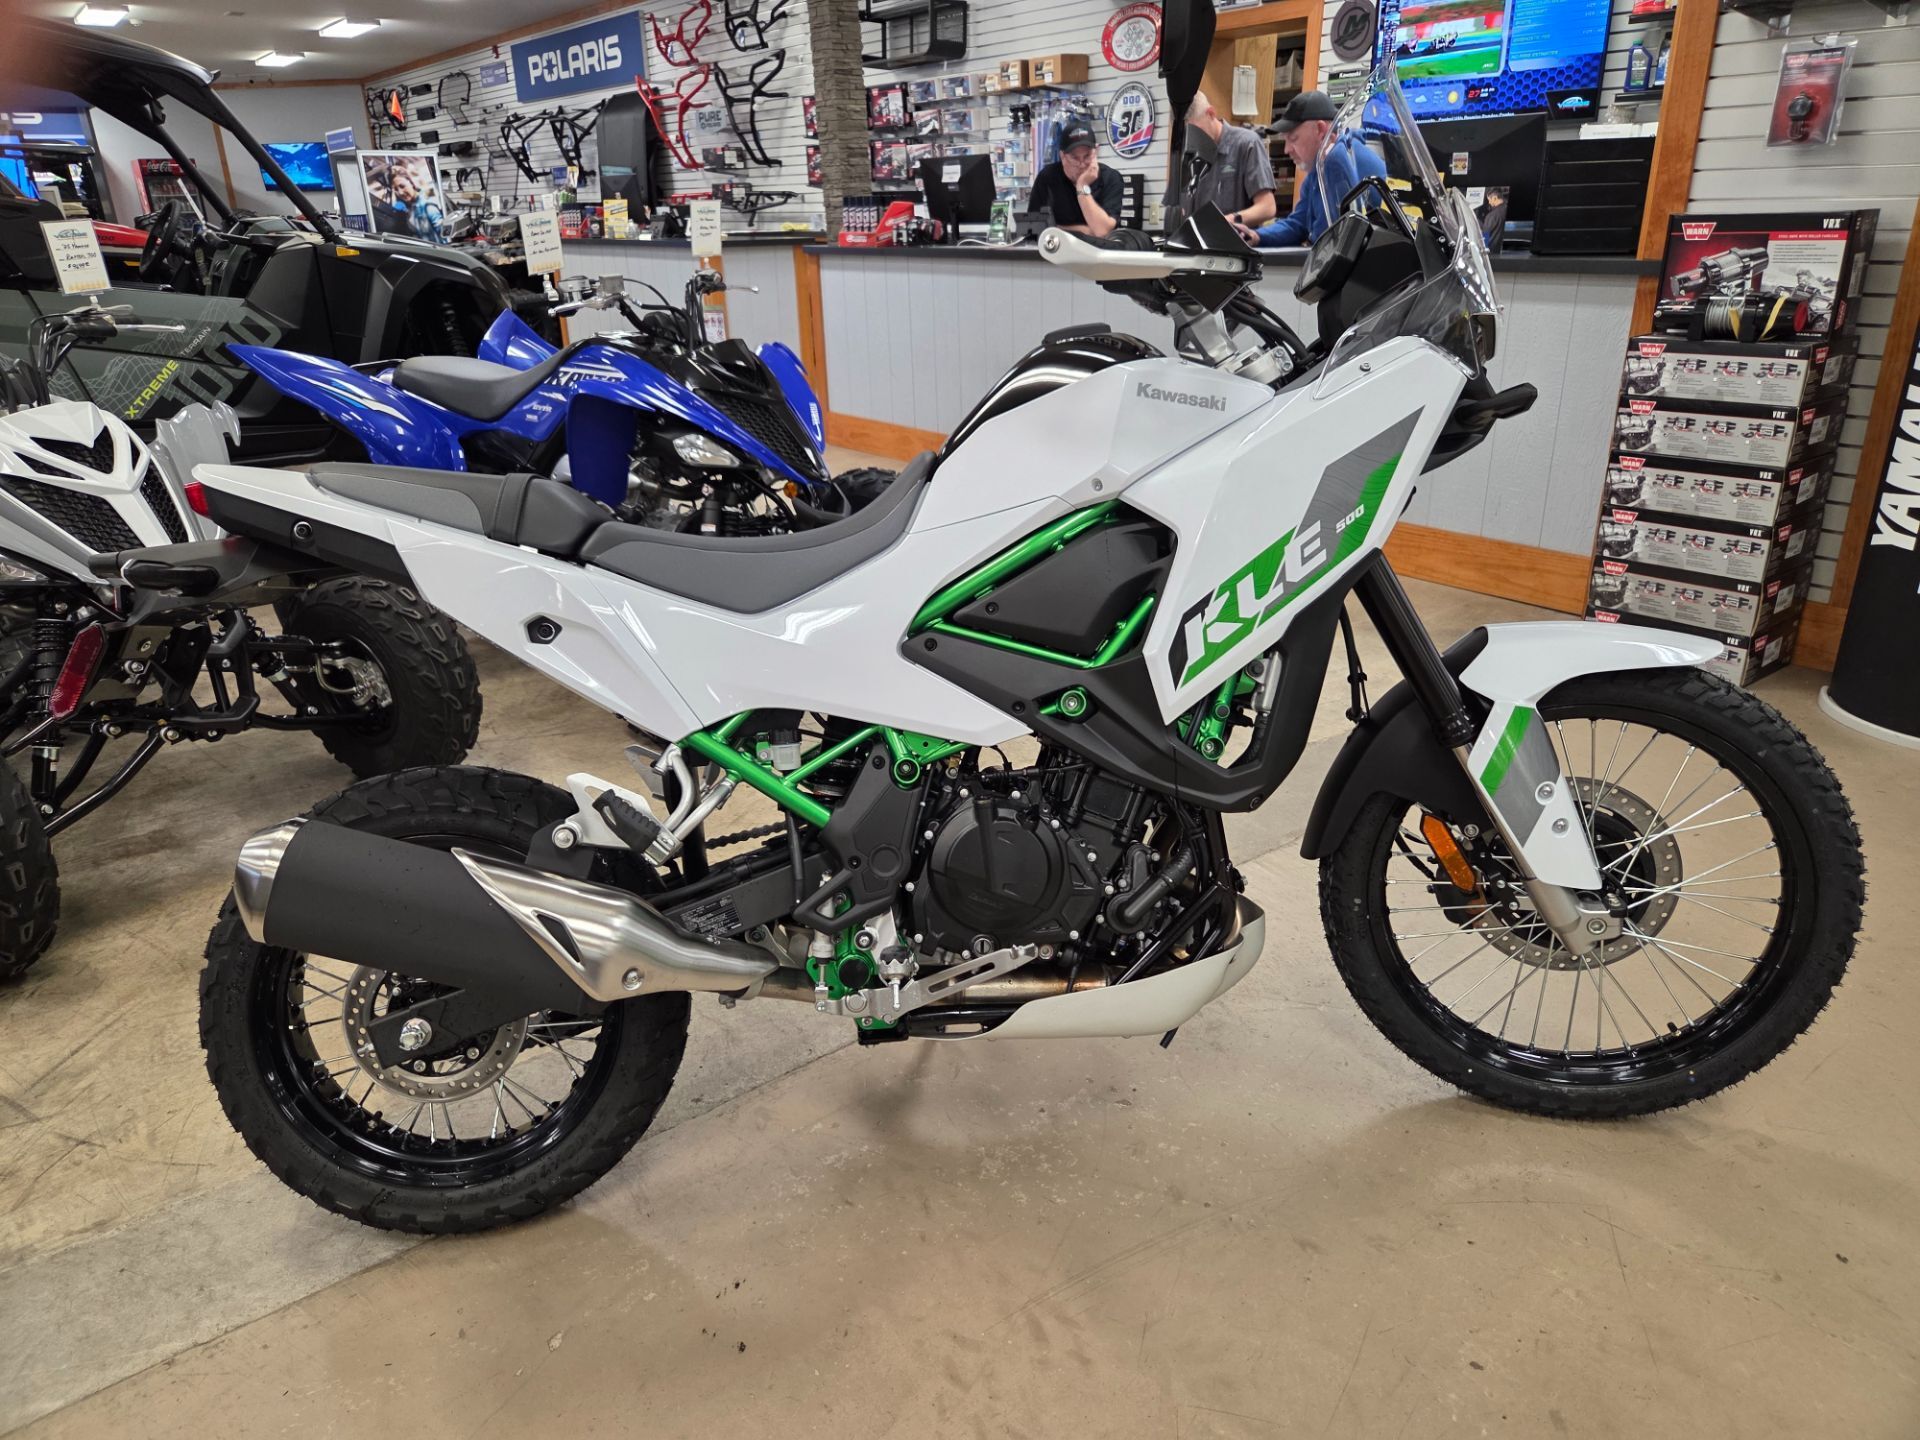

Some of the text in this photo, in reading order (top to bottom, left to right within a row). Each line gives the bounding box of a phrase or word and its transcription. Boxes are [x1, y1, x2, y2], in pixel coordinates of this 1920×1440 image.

[527, 34, 622, 86] POLARIS
[698, 110, 722, 122] PURE
[1822, 218, 1841, 230] VRX
[1686, 227, 1710, 237] WARN
[179, 326, 212, 356] TERRAIN
[125, 359, 180, 420] XTREME
[1136, 382, 1227, 412] Kawasaki
[1772, 411, 1786, 419] VRX
[1759, 472, 1773, 480] VRX
[1750, 529, 1763, 537] VRX
[1184, 504, 1365, 660] KLE 500
[1737, 584, 1750, 593] VRX
[1598, 615, 1739, 645] WARN VRX
